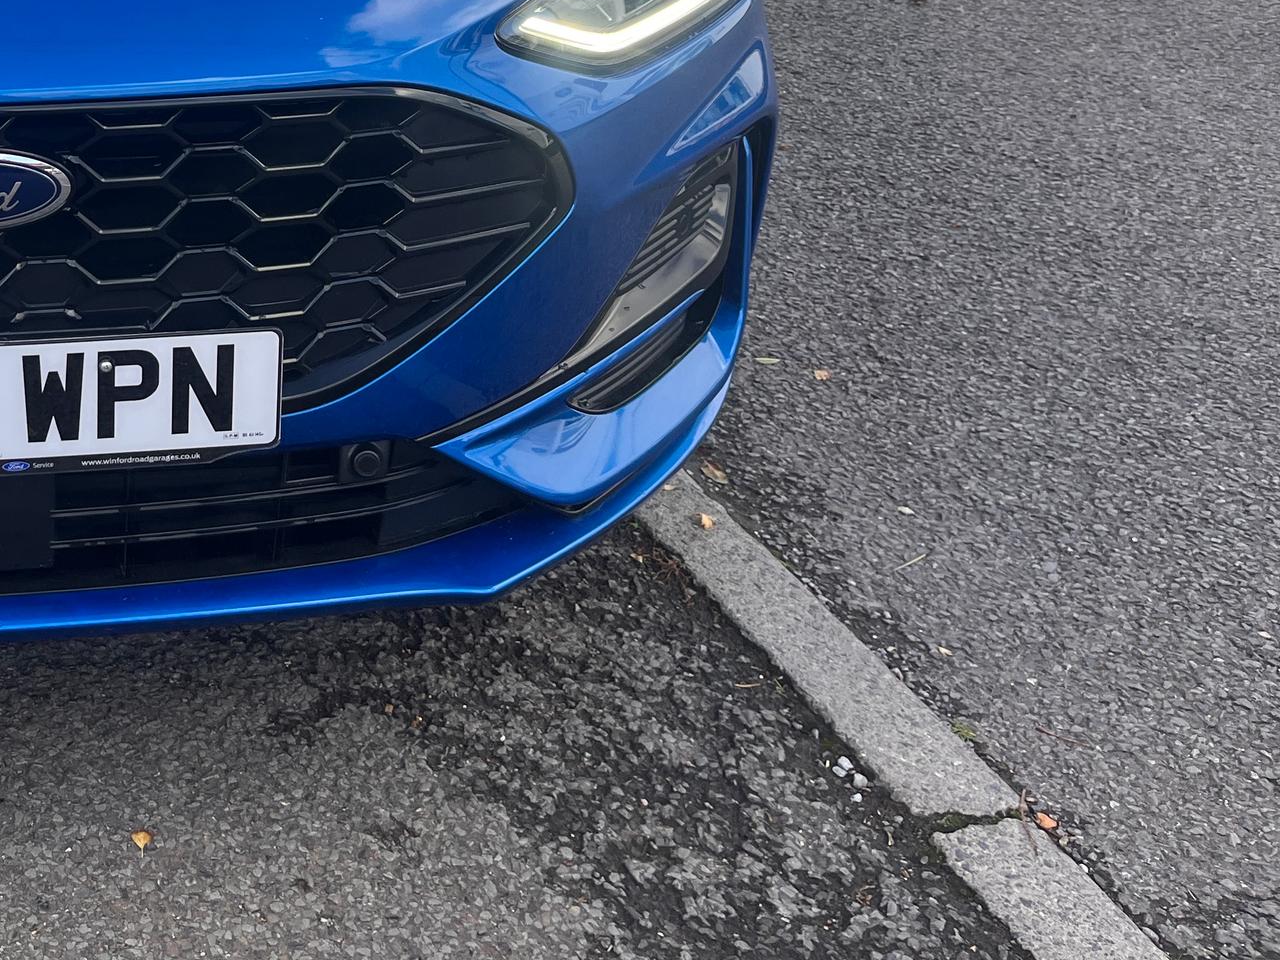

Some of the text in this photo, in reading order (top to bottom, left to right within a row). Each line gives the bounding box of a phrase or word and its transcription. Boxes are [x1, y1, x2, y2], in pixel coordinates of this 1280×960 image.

[21, 343, 236, 443] WPN
[32, 461, 55, 469] Service
[81, 452, 201, 466] www.winfordroadgarages.co.uk
